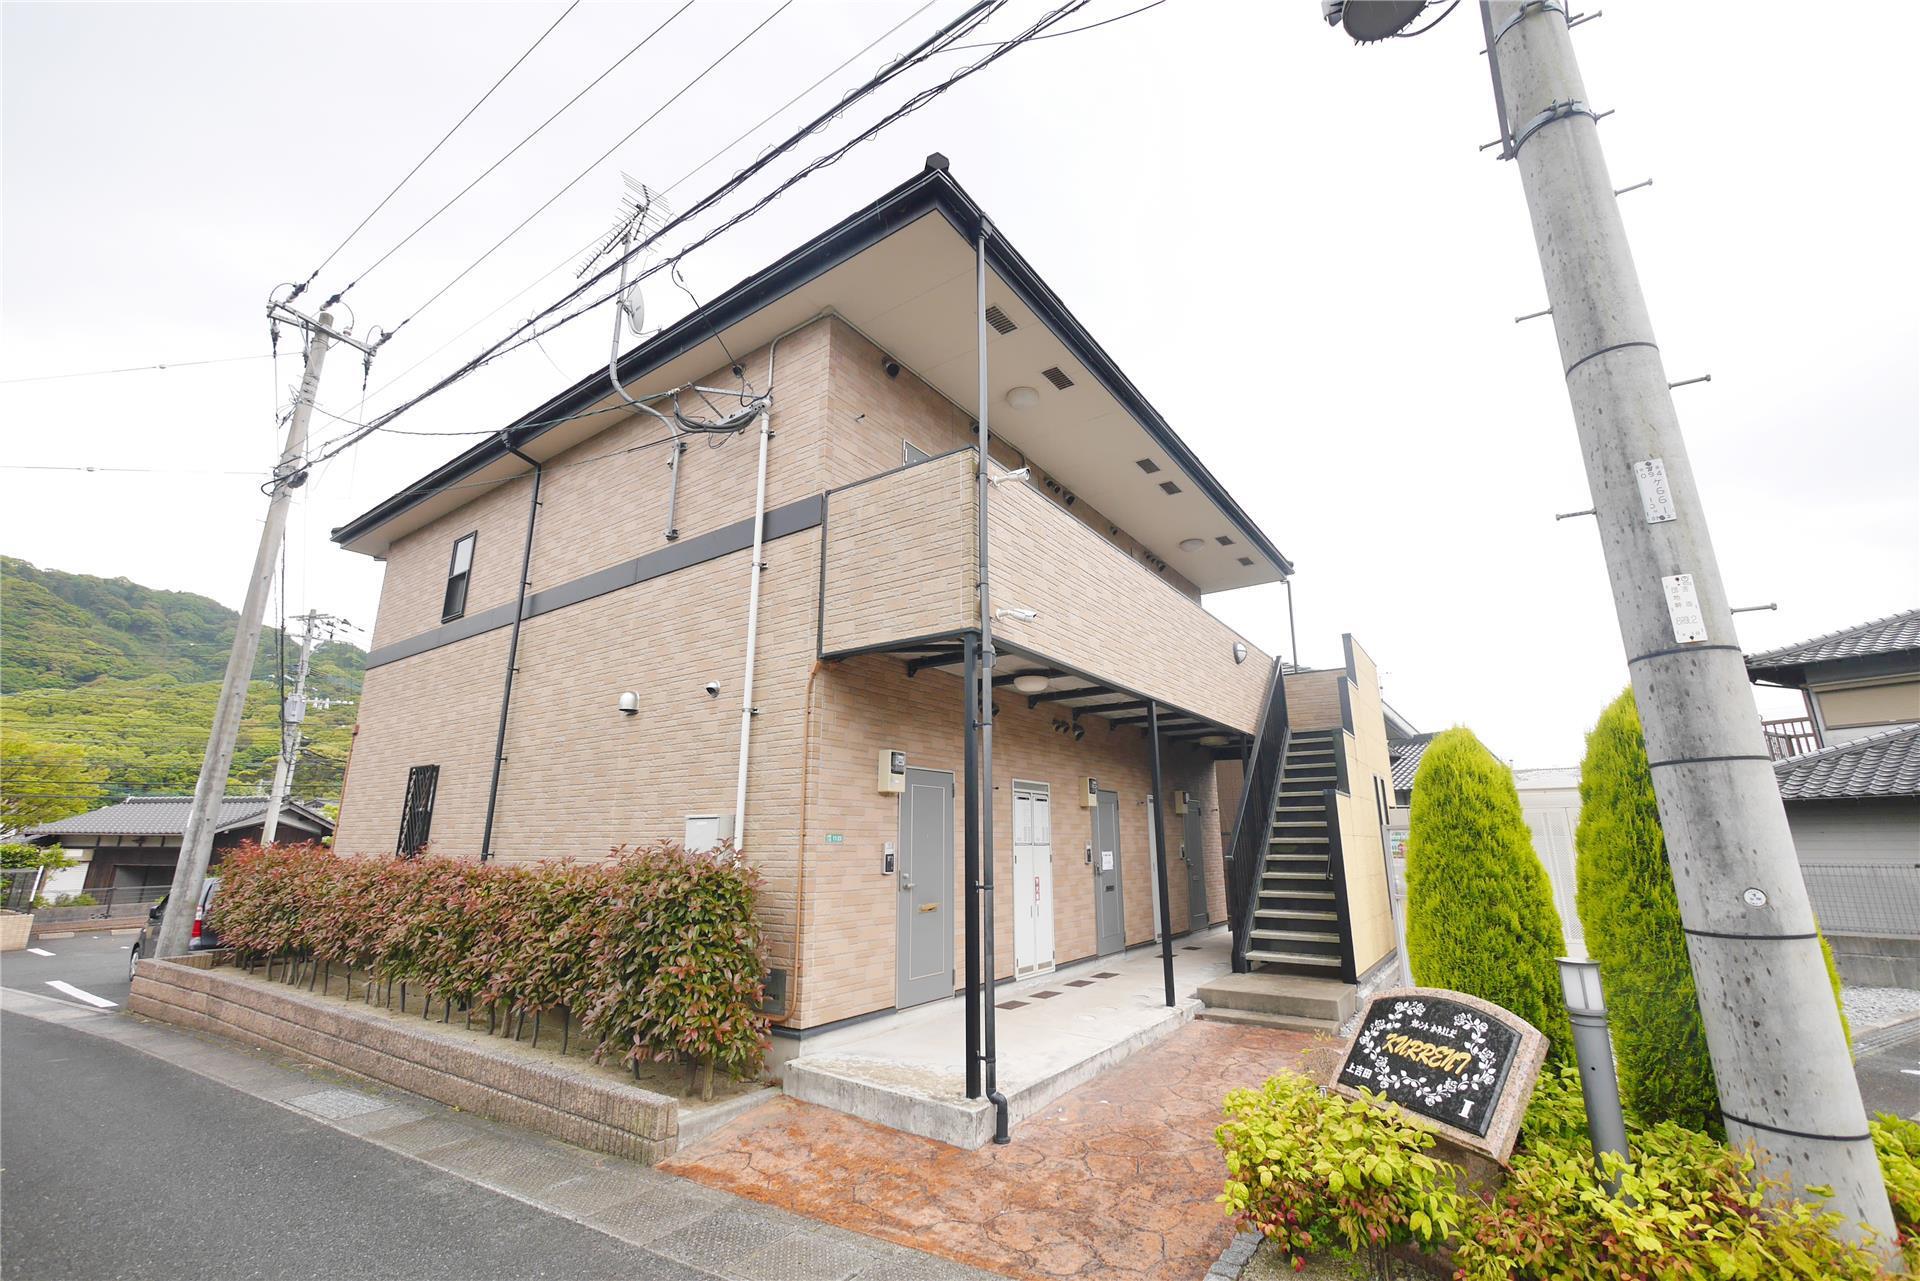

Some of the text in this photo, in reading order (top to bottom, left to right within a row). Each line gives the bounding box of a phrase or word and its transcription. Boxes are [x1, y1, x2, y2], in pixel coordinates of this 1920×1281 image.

[1382, 1033, 1472, 1075] KURRENT
[1345, 1062, 1373, 1080] 上吉田
